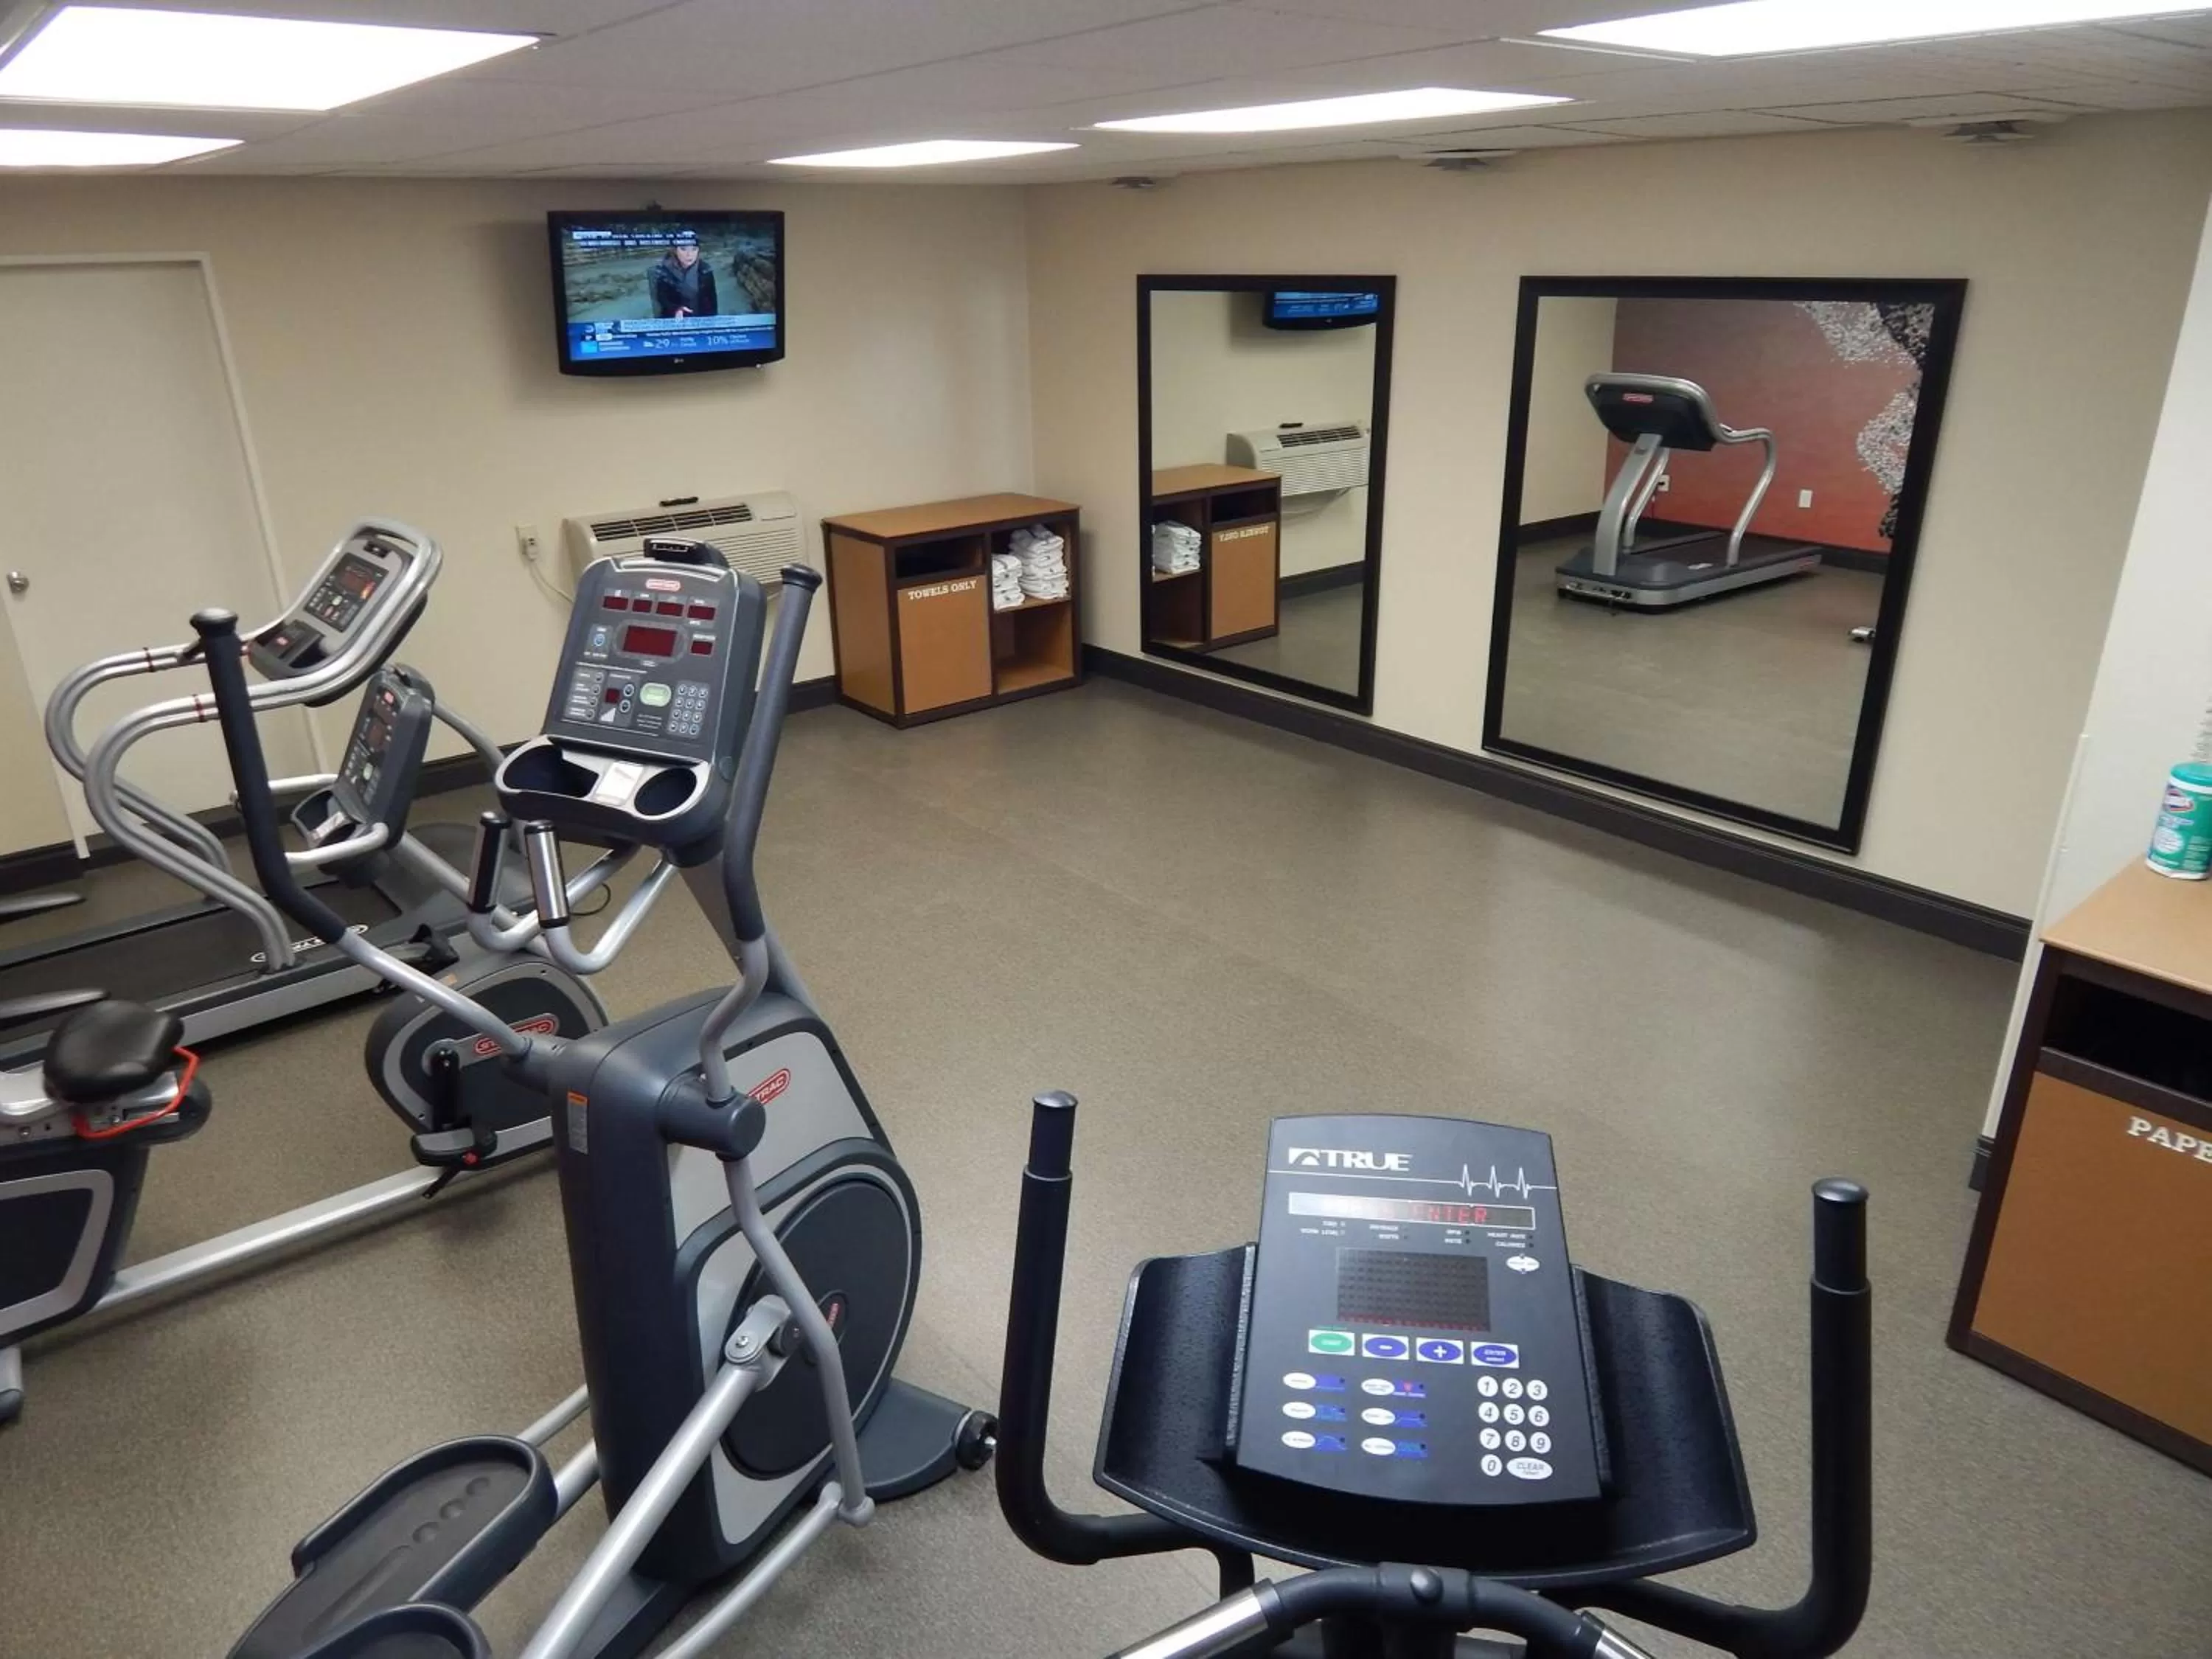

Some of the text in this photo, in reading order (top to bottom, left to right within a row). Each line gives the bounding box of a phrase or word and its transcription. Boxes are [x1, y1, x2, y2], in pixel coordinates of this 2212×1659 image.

[706, 335, 728, 346] 10%
[908, 580, 977, 599] TOWELS ONLY
[2126, 1116, 2212, 1164] PAPE
[1321, 1149, 1413, 1172] TRUE
